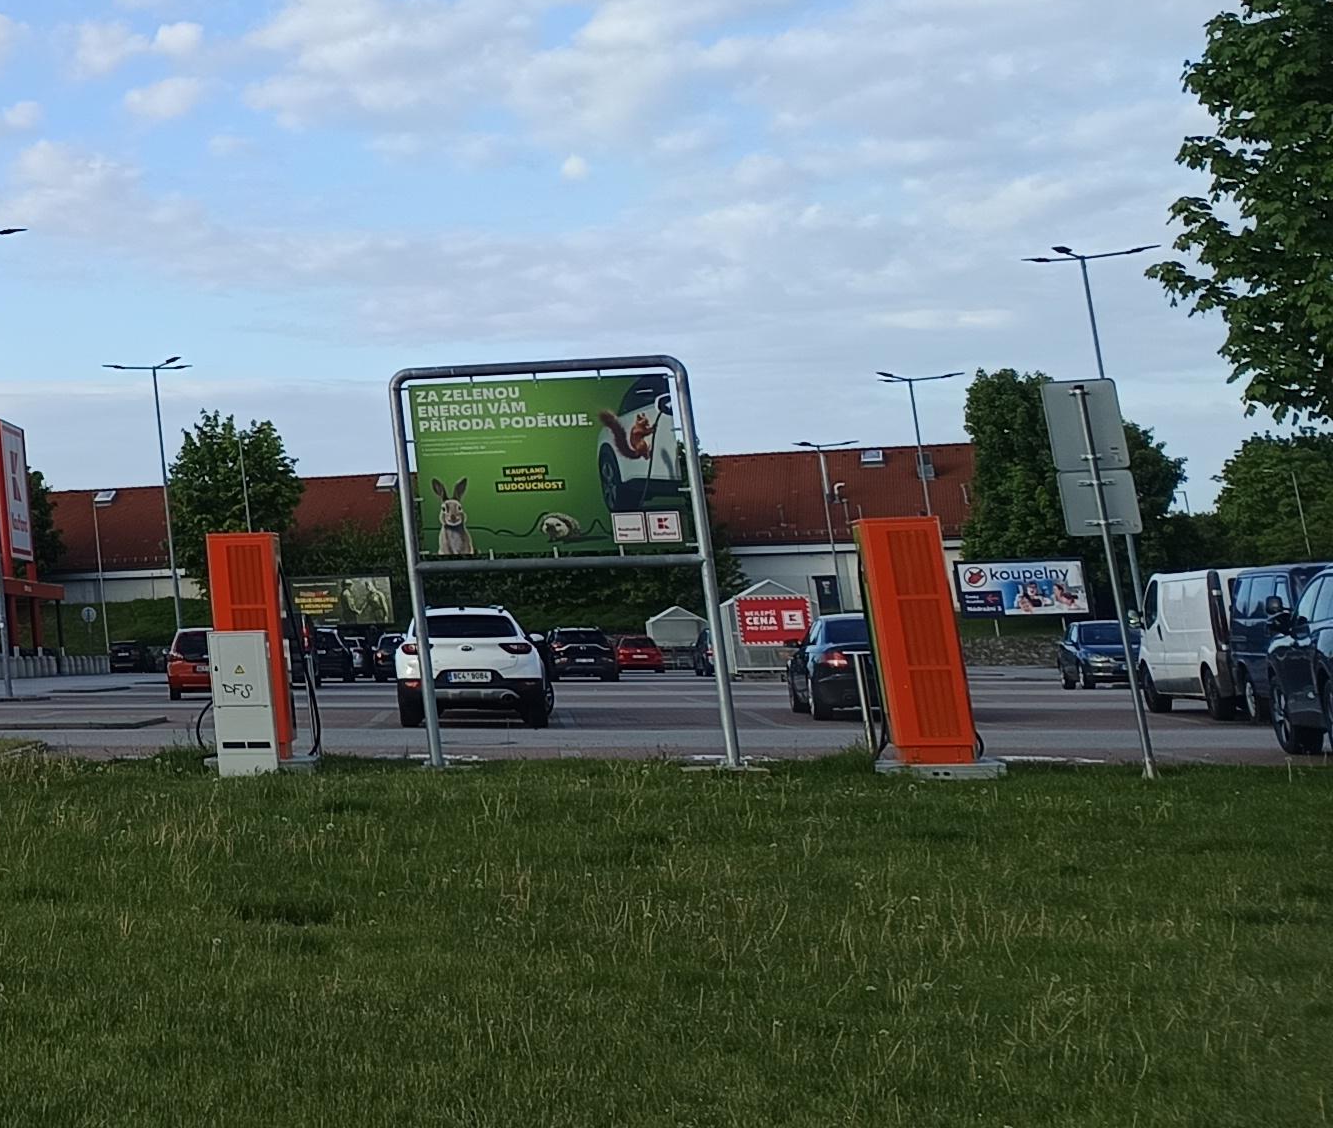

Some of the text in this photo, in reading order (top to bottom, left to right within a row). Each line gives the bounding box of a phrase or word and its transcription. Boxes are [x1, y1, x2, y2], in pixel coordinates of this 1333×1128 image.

[415, 386, 520, 403] ZA ZELENOU
[417, 400, 527, 418] ENERGII VÁM
[419, 411, 594, 433] PŘÍRODA PODĚKUJE.
[505, 466, 546, 475] KAUFLAND
[497, 481, 563, 491] BUDOUCNOST
[989, 566, 1069, 583] koupelny
[745, 616, 778, 626] CENA
